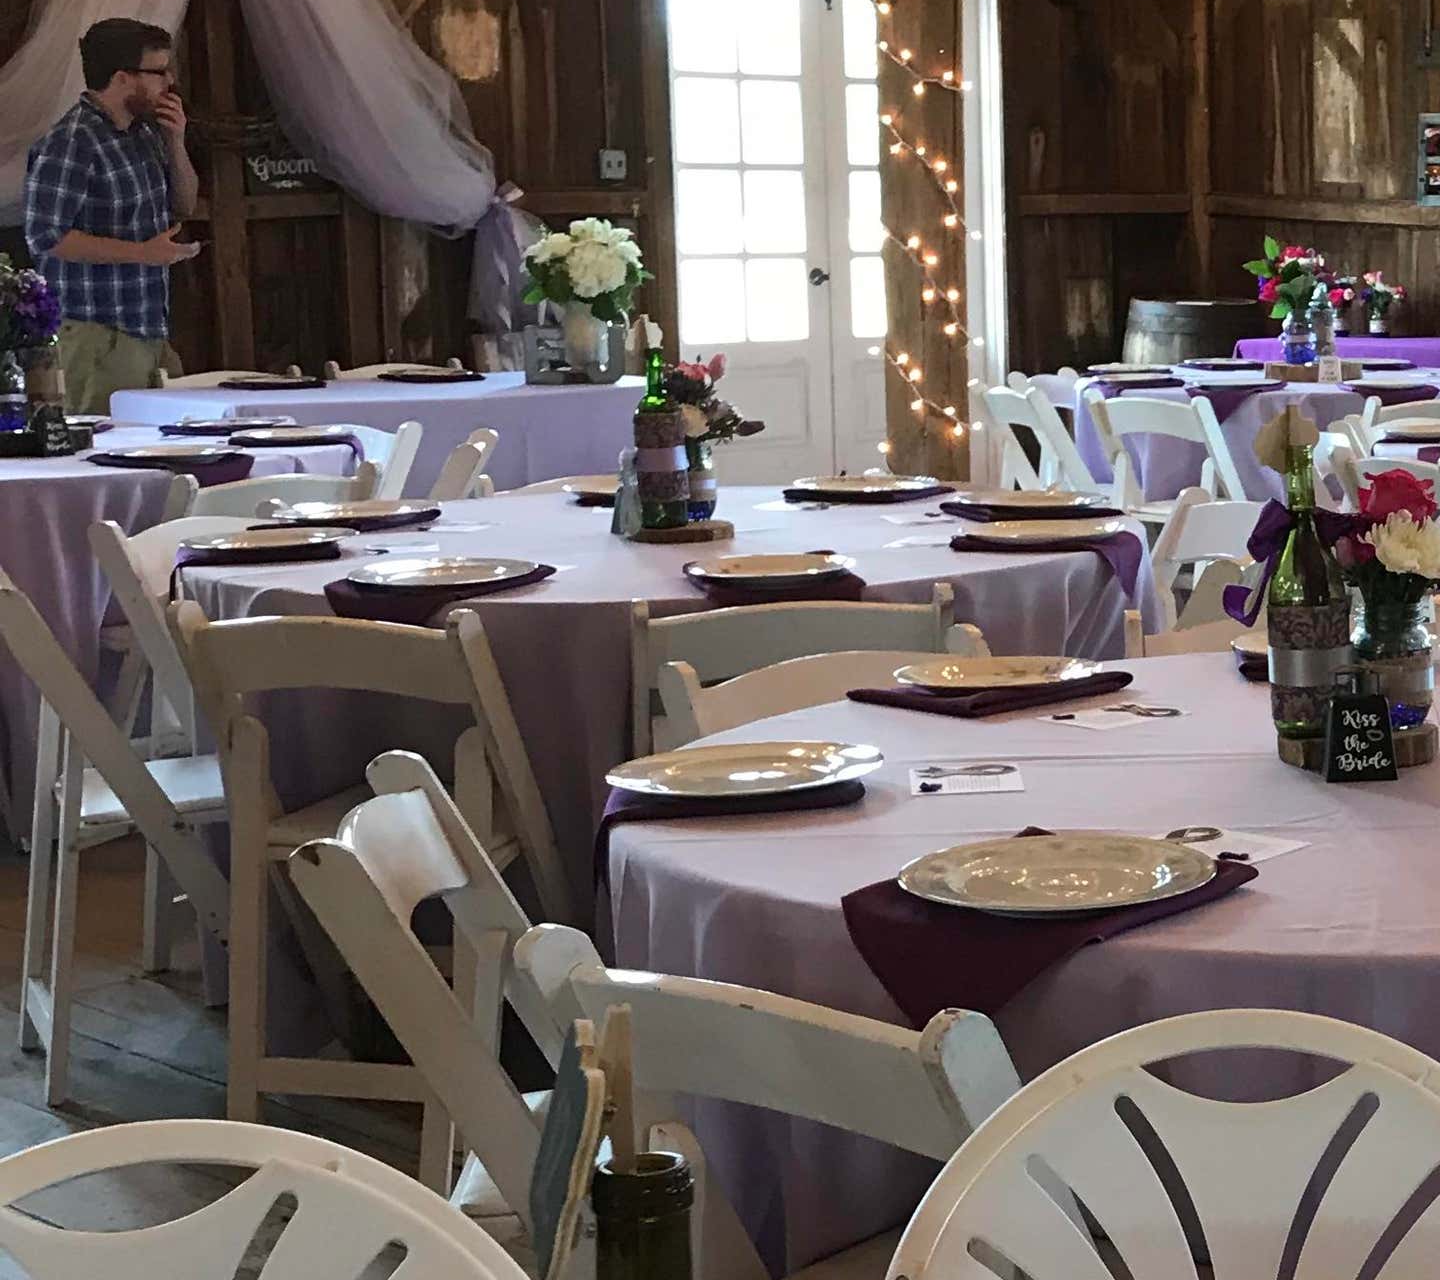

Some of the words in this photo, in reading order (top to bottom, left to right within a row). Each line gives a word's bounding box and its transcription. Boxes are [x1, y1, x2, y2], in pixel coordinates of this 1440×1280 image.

[247, 154, 318, 181] Groom
[1341, 710, 1380, 729] Kiss
[1344, 734, 1370, 752] the
[1336, 751, 1391, 772] Bride
